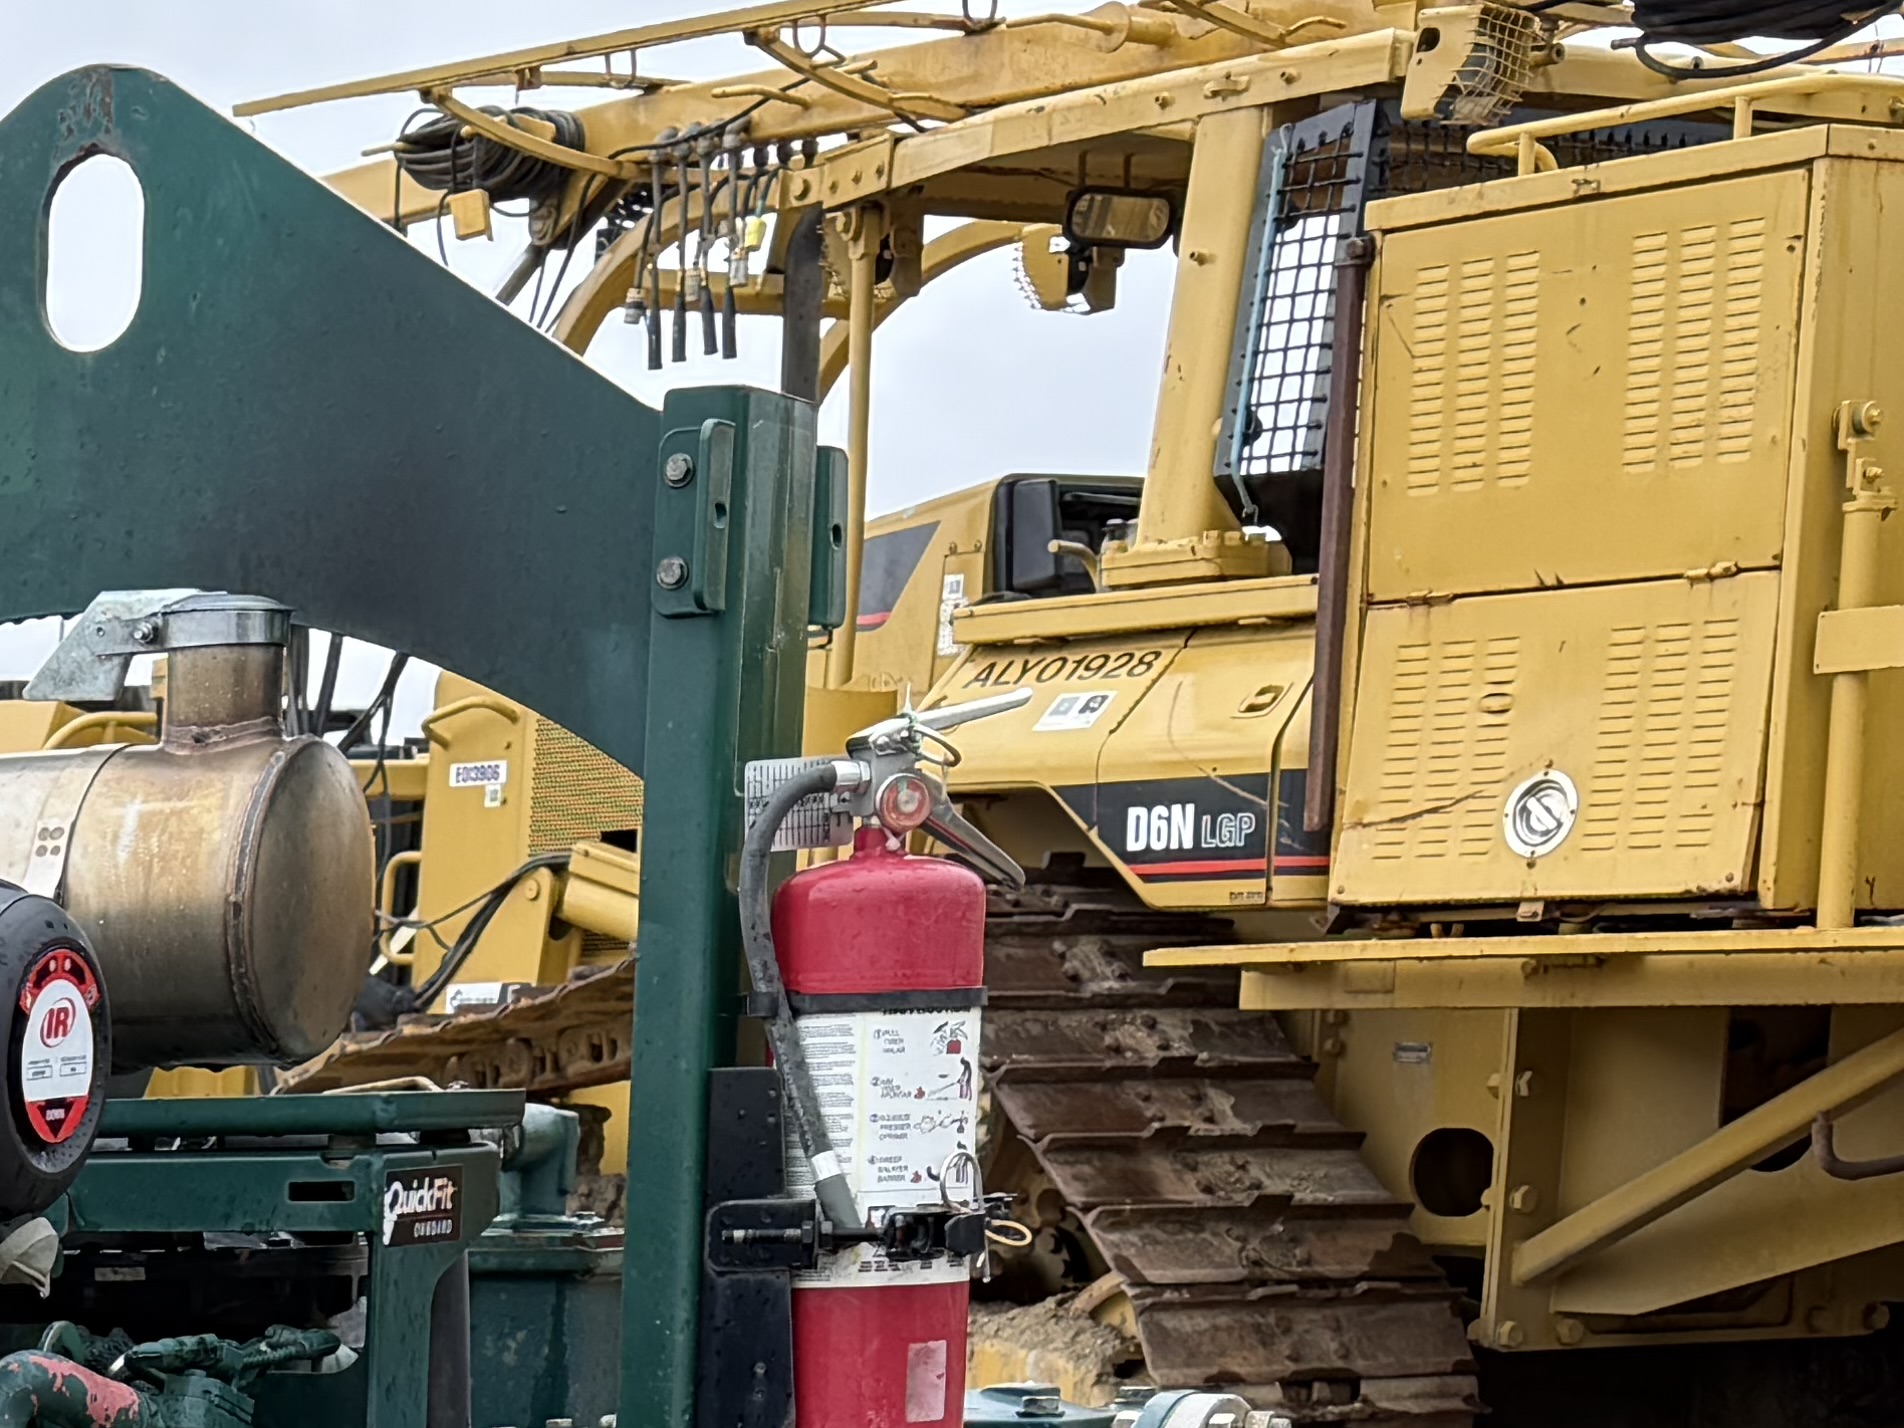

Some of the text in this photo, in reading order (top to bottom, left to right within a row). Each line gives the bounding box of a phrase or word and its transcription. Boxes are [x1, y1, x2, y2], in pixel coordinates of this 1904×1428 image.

[961, 650, 1162, 690] ALY01928
[1126, 802, 1256, 853] D6N LGP
[45, 1006, 71, 1040] IR
